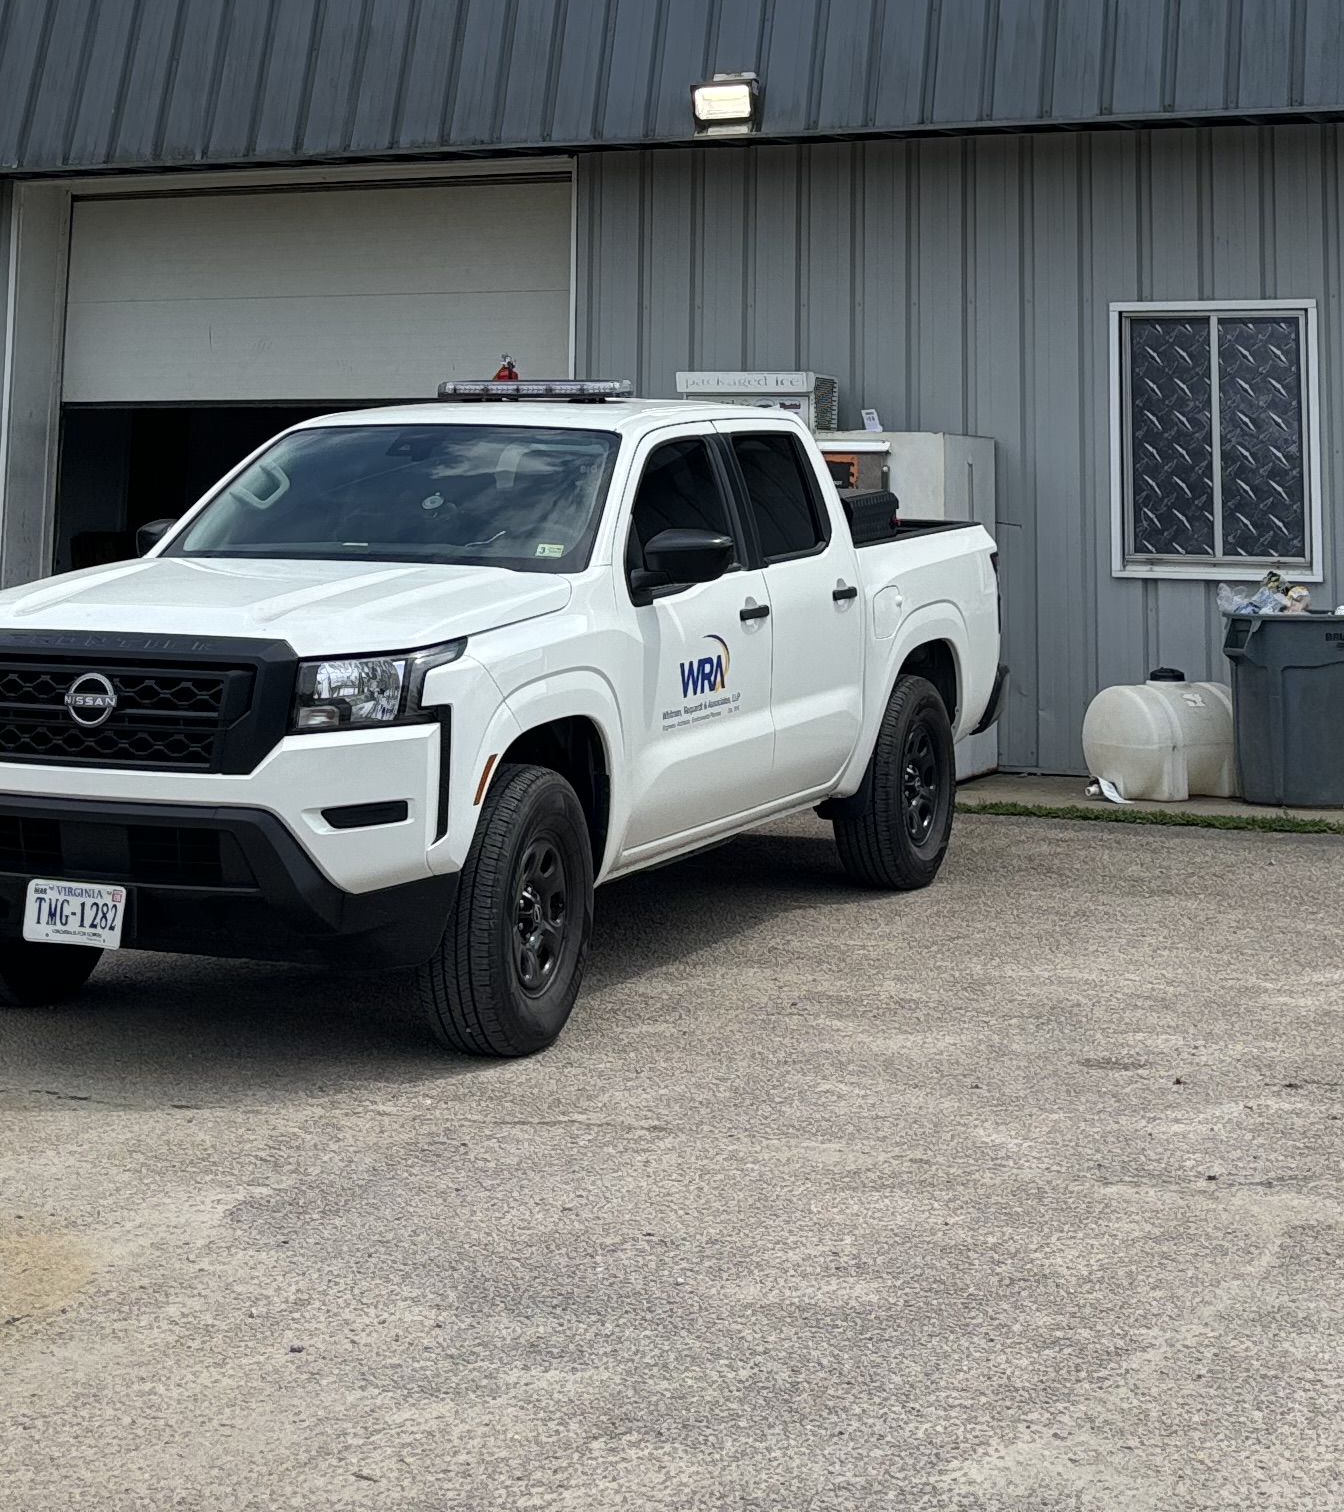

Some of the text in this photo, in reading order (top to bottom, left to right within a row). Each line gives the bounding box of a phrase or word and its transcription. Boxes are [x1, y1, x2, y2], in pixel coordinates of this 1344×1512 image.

[680, 655, 725, 698] WRA
[64, 695, 116, 706] NISSAN
[56, 885, 104, 900] VIRGINIA
[35, 896, 118, 931] TMG-1282
